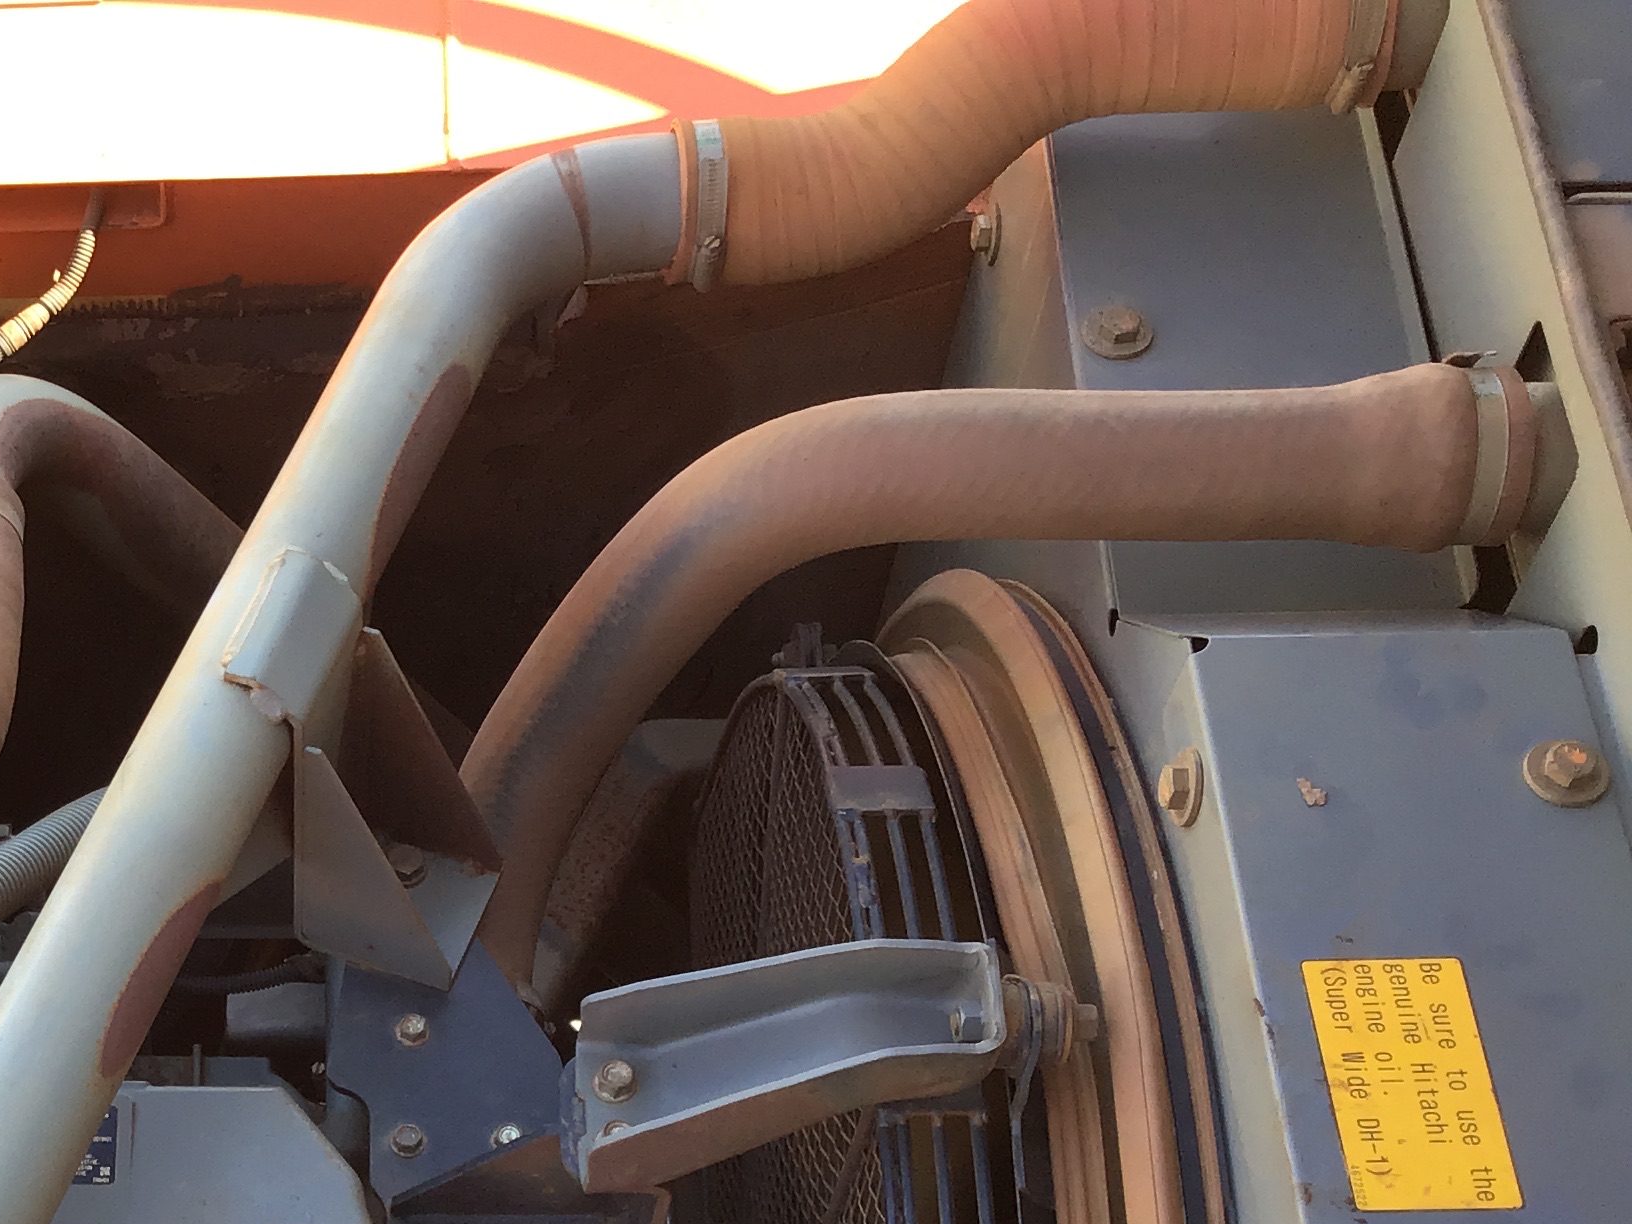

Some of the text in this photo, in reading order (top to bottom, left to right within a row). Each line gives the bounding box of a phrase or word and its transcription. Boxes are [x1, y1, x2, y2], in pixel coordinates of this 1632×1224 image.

[1321, 968, 1393, 1175] (Super Wide DH-1)
[1354, 964, 1404, 1095] engine oil.
[1383, 964, 1452, 1143] genuine Hitachi
[1419, 962, 1496, 1202] Be sure to use the
